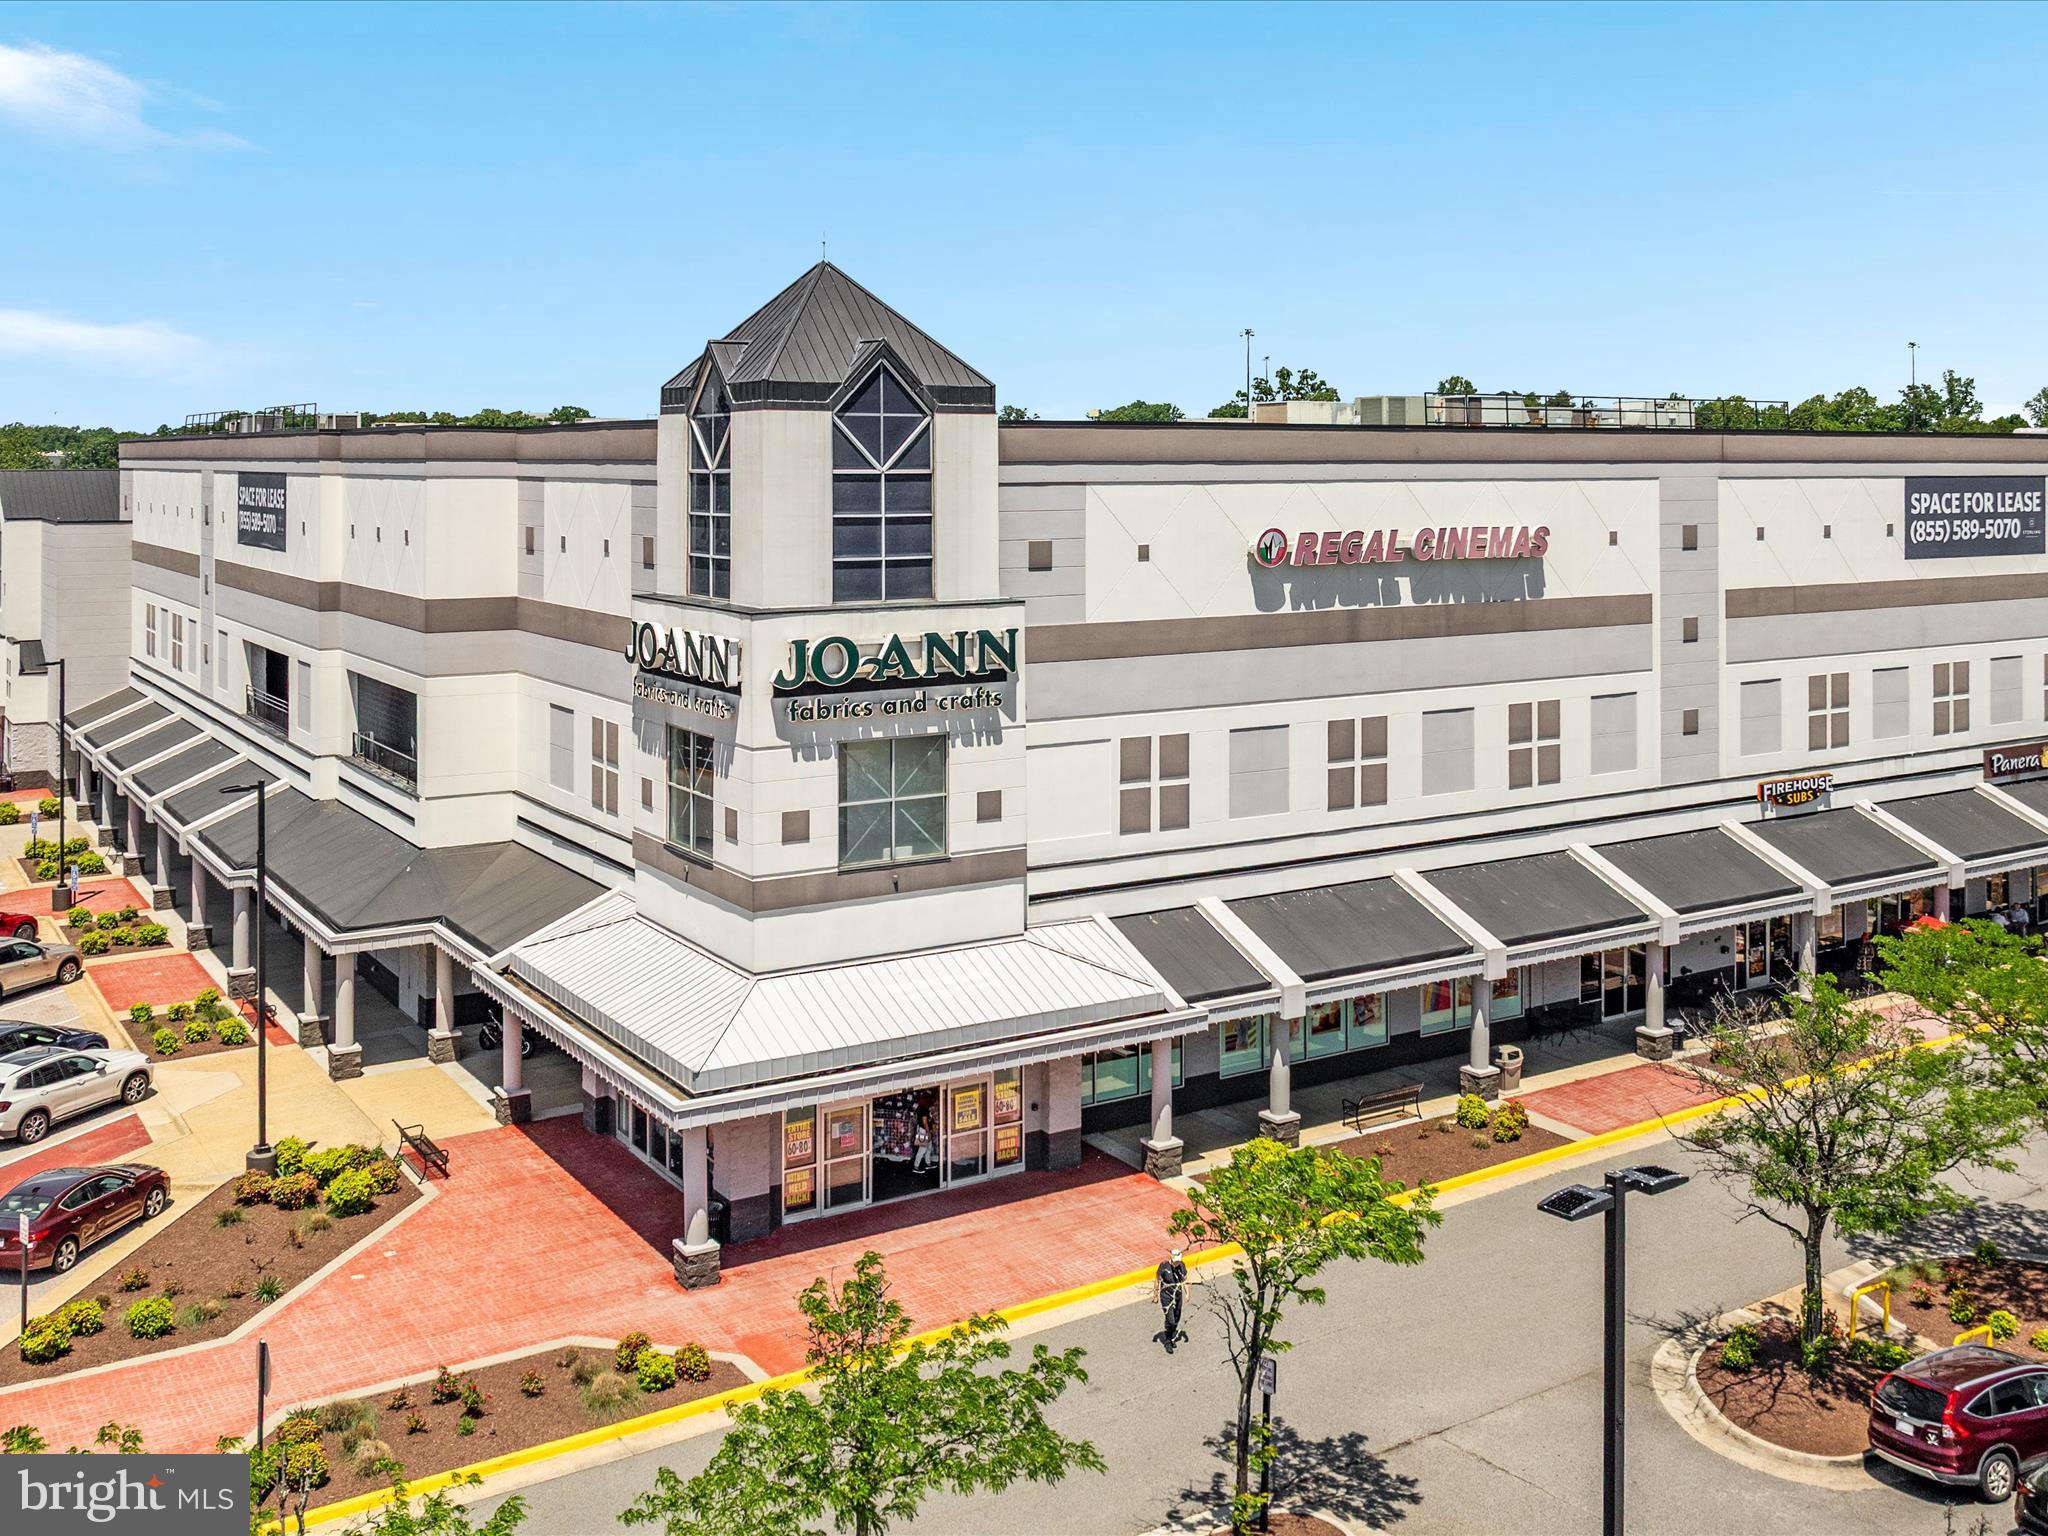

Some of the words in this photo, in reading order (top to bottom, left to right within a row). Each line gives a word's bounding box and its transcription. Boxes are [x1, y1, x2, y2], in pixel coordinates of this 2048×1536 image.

[239, 487, 255, 506] SPACE
[256, 488, 267, 508] FOR
[267, 488, 285, 509] LEASE
[1910, 492, 1961, 514] SPACE
[1963, 492, 1994, 513] FOR
[1997, 491, 2042, 513] LEASE
[1910, 519, 1950, 544] (855)
[1952, 518, 2021, 540] 589-5070
[1290, 528, 1405, 566] REGAL
[1411, 526, 1551, 561] CINEMAS
[633, 676, 667, 703] fabrics
[669, 688, 691, 709] and
[694, 695, 728, 719] crafts
[788, 697, 873, 722] fabrics
[881, 690, 928, 715] and
[937, 685, 1004, 711] crafts
[1991, 753, 2040, 774] Panera
[1763, 776, 1834, 801] FIREHOUSE
[1787, 790, 1814, 805] SUBS
[788, 1130, 811, 1142] STORE
